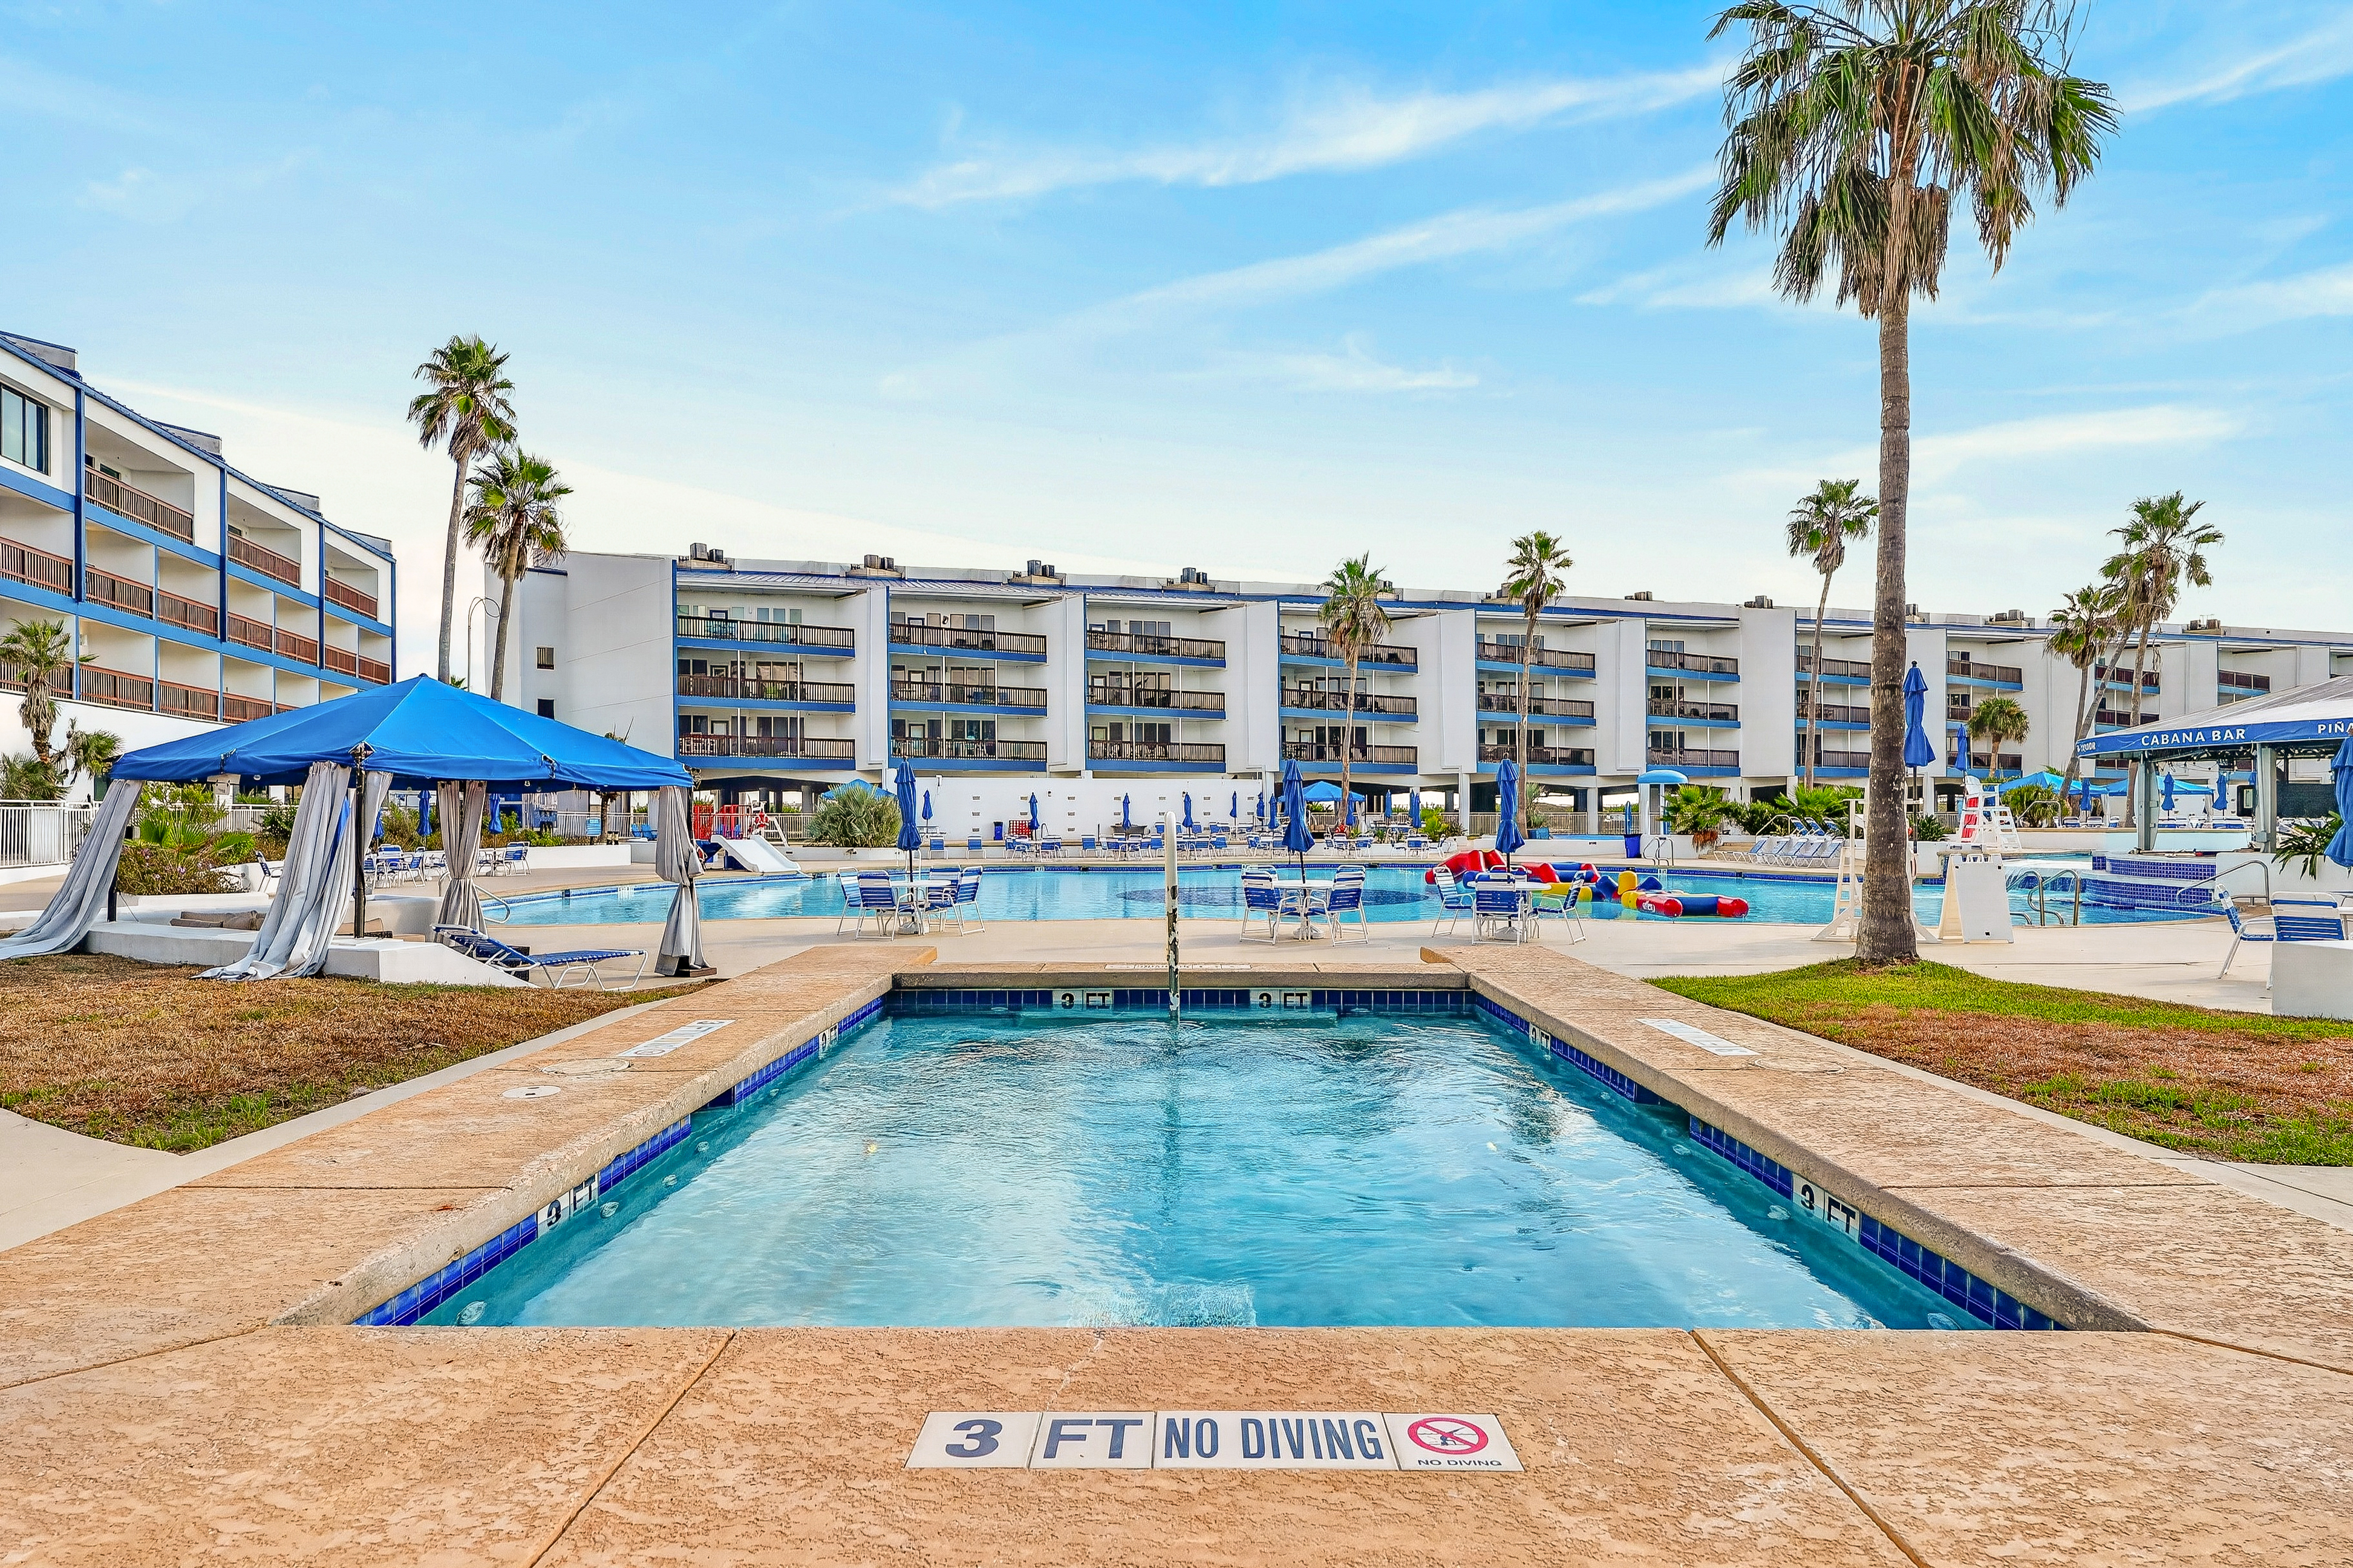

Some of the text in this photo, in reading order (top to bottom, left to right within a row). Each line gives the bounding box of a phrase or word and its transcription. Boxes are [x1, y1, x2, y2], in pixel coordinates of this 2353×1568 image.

[2141, 729, 2245, 746] CABANA BAR
[573, 1175, 595, 1211] FT
[1827, 1196, 1856, 1234] FT
[945, 1417, 1384, 1459] 3 FT NO DIVING
